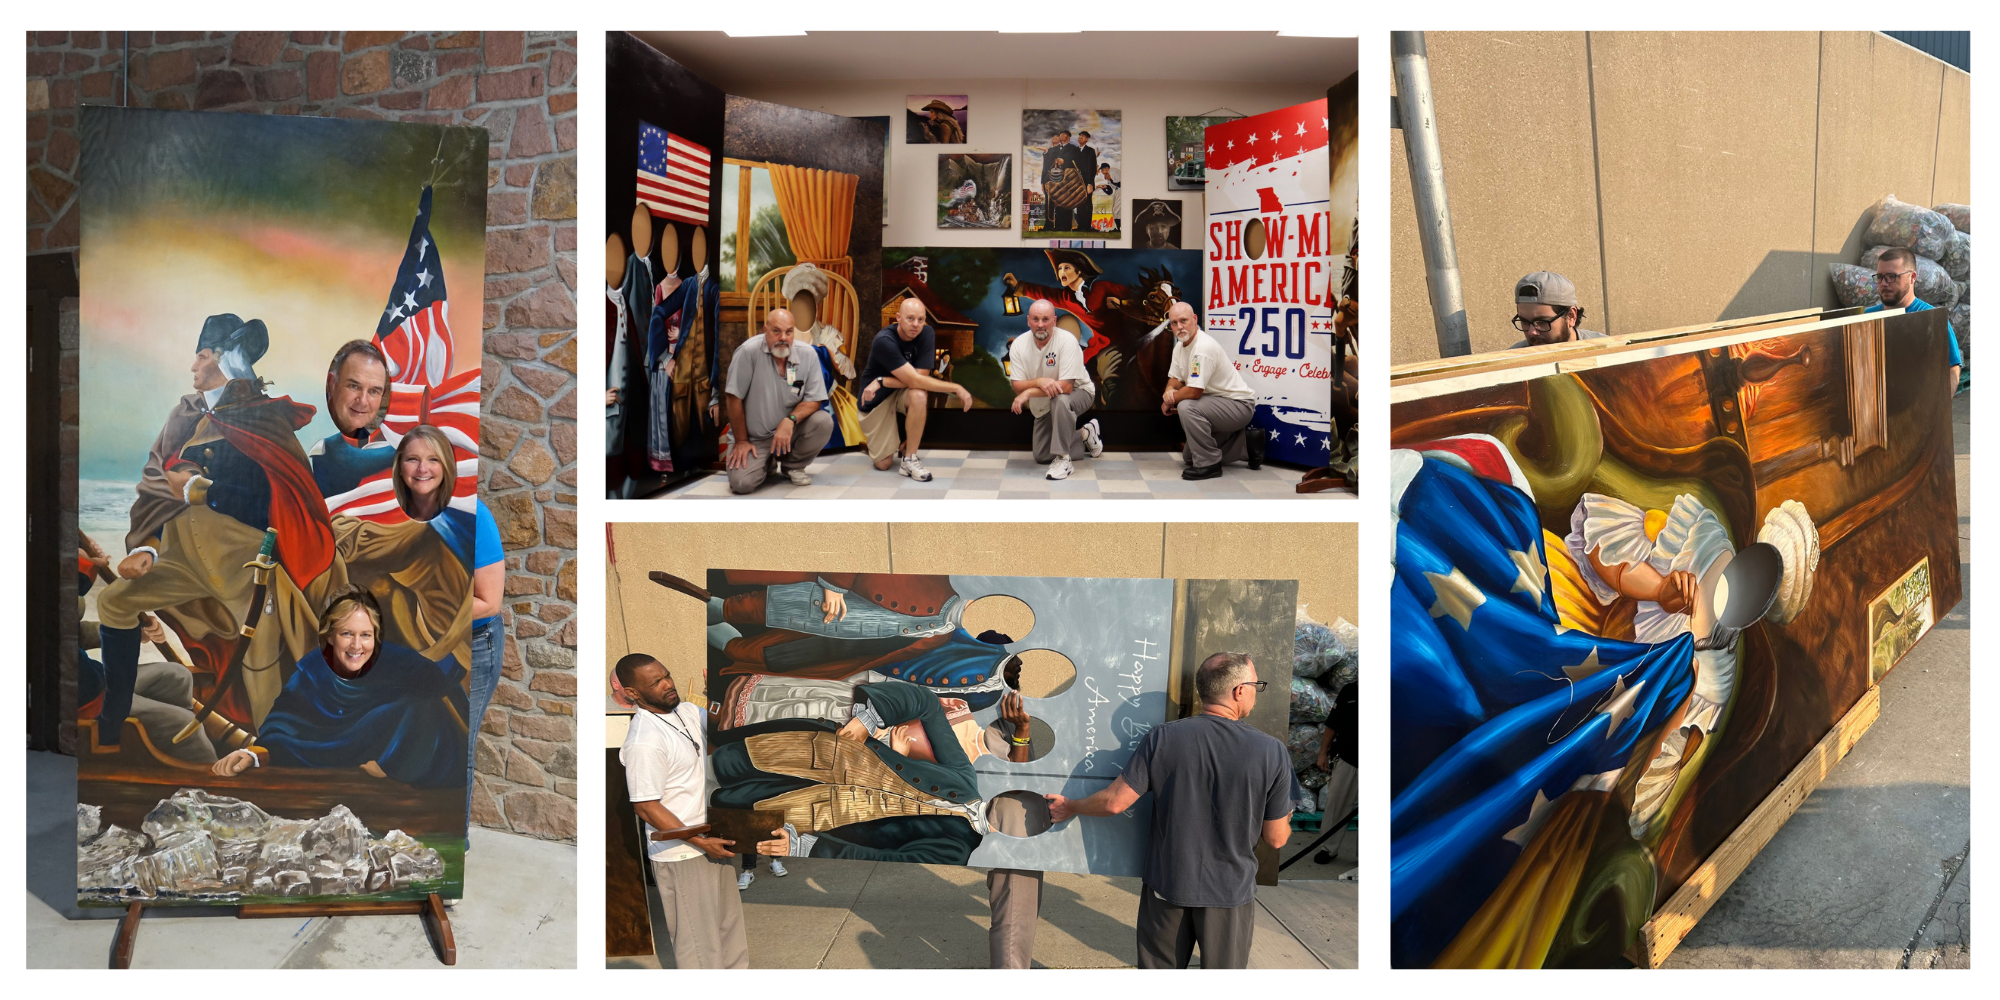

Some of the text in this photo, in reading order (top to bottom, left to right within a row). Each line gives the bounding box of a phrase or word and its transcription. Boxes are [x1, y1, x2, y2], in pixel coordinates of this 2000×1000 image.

[1238, 307, 1306, 360] 250
[1252, 358, 1288, 379] Engage
[1116, 637, 1158, 708] Happy
[1084, 675, 1111, 773] America
